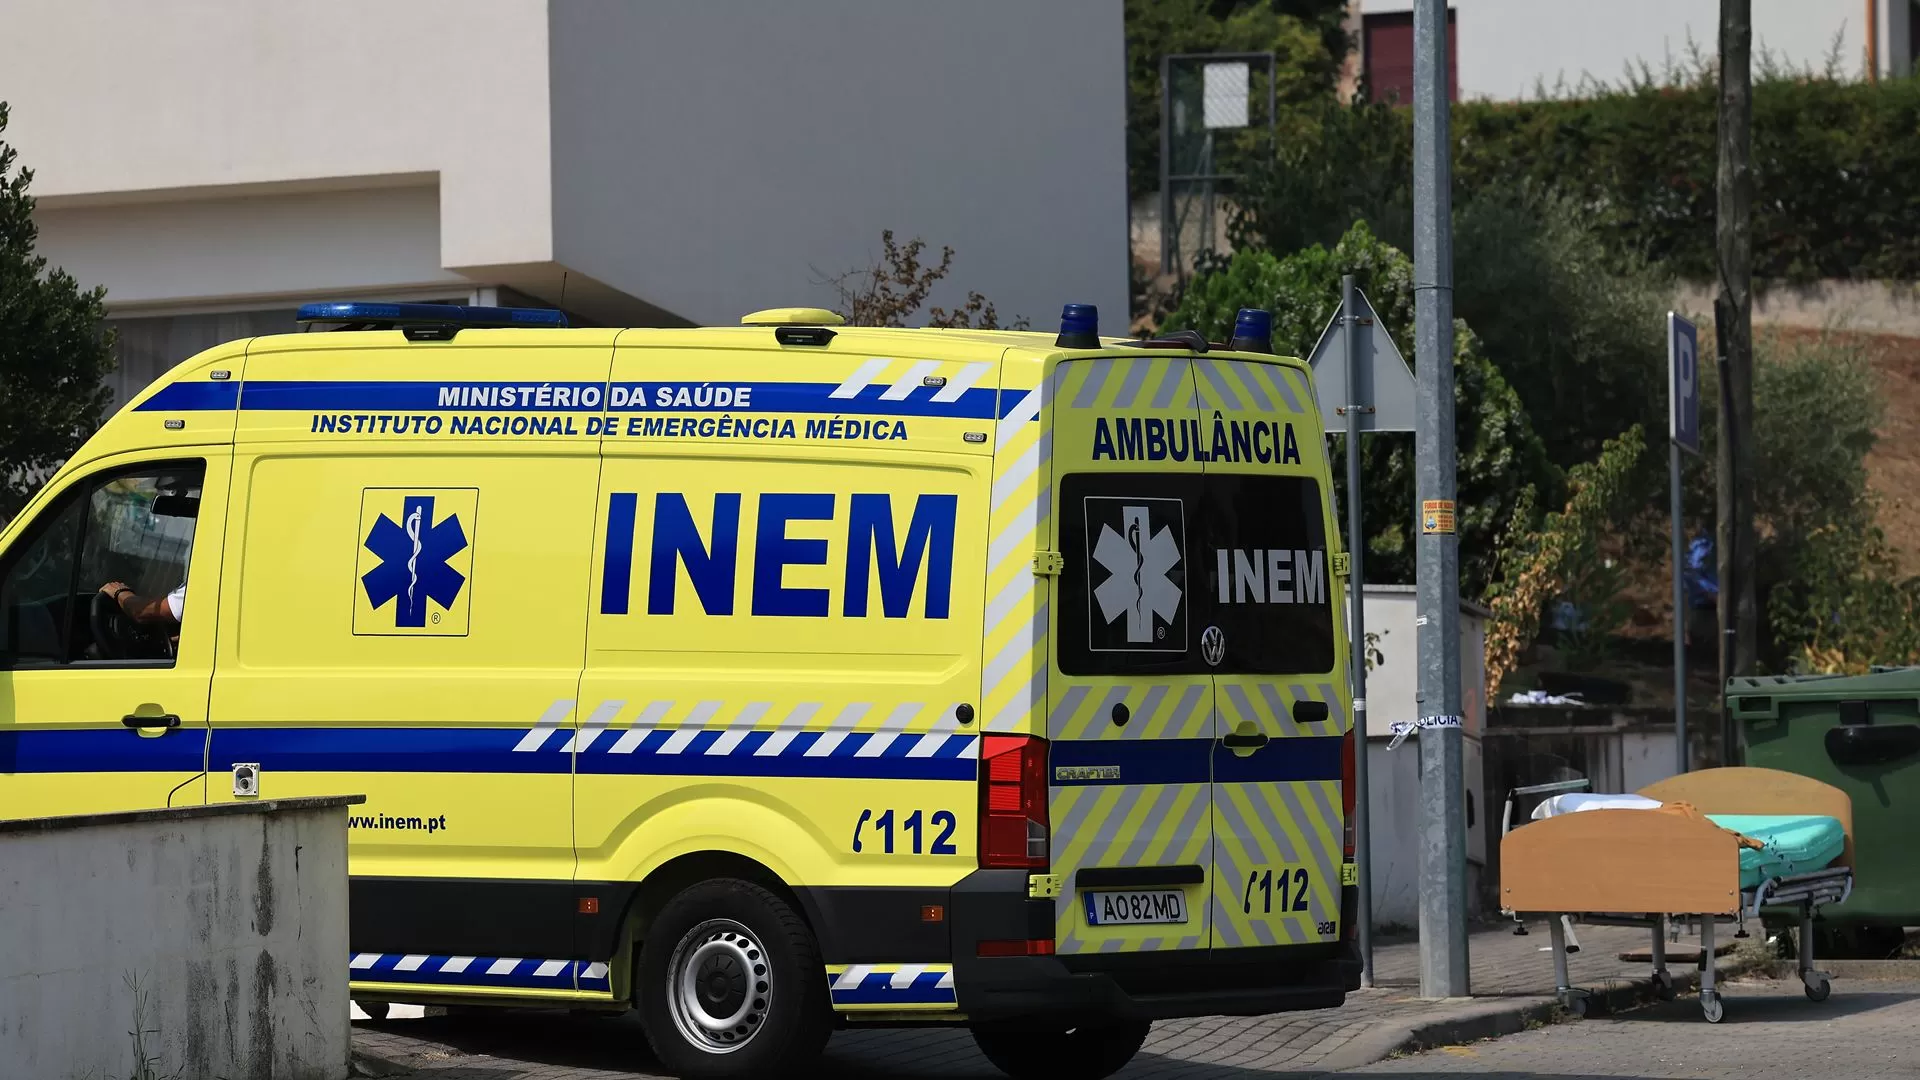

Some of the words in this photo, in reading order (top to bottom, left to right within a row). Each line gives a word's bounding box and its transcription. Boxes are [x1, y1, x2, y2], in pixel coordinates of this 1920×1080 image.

[438, 383, 601, 407] MINISTÉRIO
[610, 387, 647, 407] DA
[655, 383, 751, 407] SAÚDE
[1678, 331, 1694, 432] P
[310, 414, 443, 434] INSTITUTO
[449, 416, 578, 435] NACIONAL
[585, 417, 619, 436] DE
[626, 414, 796, 439] EMERGÊNCIA
[804, 415, 909, 440] MÉDICA
[1092, 411, 1301, 465] AMBULÂNCIA
[600, 493, 958, 619] INEM
[1216, 549, 1325, 604] INEM
[1418, 715, 1457, 726] OLICIA
[347, 813, 446, 833] ww.inem.pt
[876, 809, 956, 855] 112
[1259, 868, 1309, 913] 112
